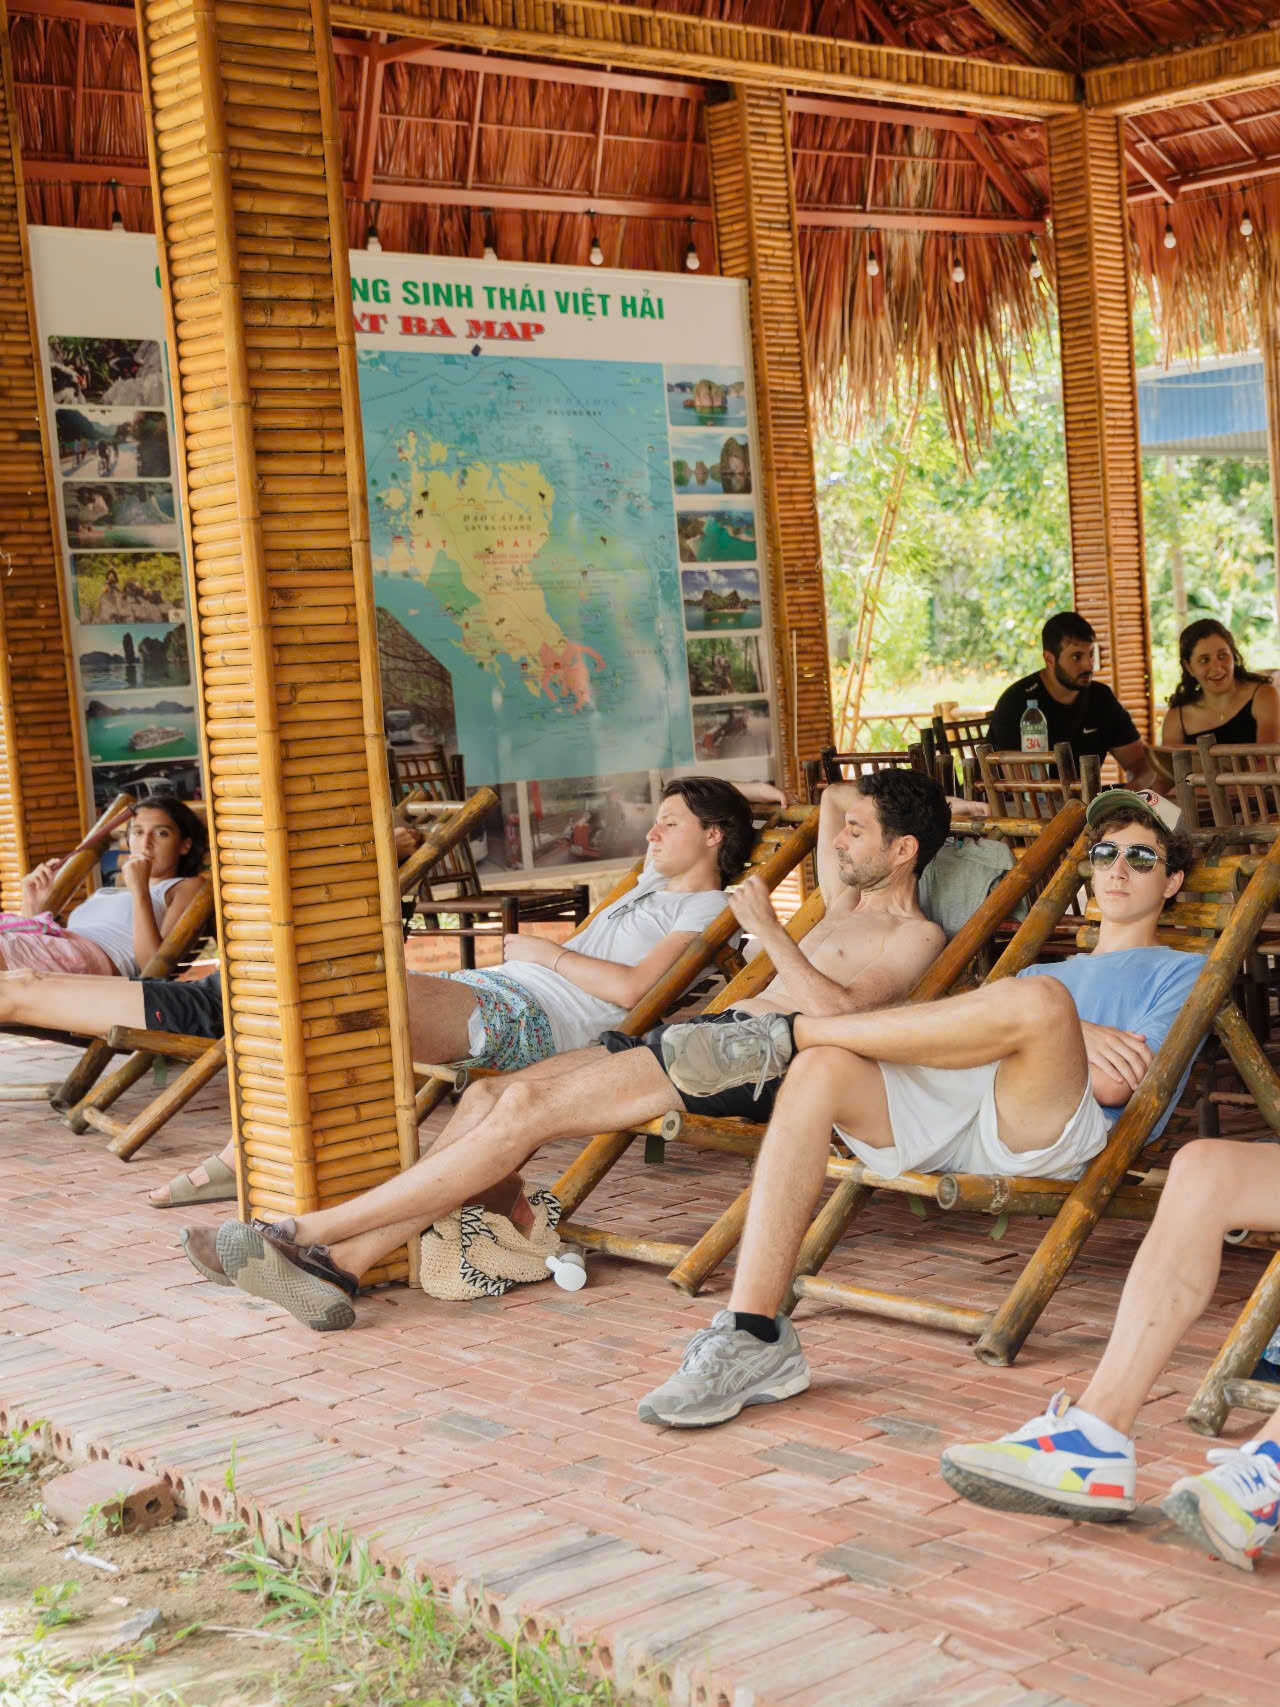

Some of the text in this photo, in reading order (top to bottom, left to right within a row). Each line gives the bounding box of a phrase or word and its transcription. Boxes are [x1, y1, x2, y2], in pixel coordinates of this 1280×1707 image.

[351, 277, 665, 321] NG SINH THÁI VIỆT HẢI
[353, 312, 545, 342] AT BA MAP
